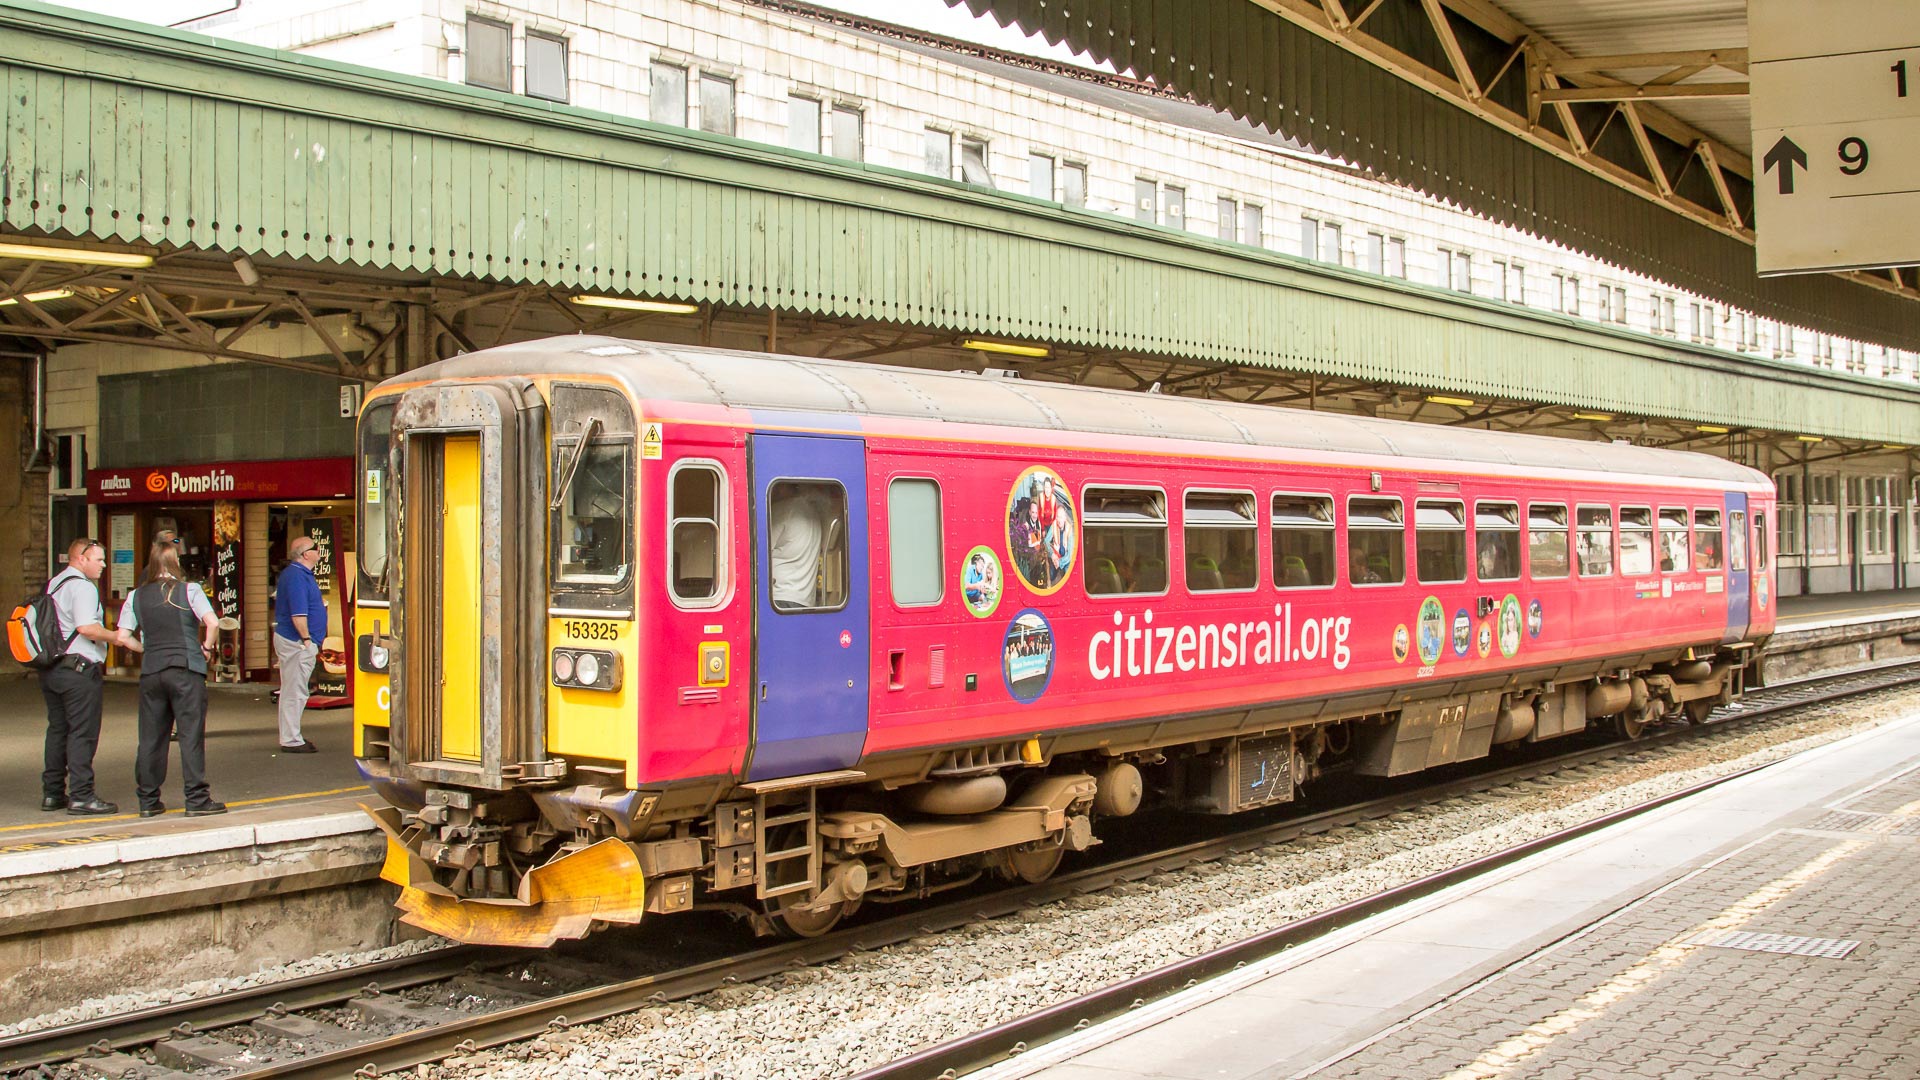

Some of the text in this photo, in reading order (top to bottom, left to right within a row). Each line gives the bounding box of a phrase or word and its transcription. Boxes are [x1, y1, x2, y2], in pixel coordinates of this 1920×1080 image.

[1838, 136, 1869, 175] 9
[171, 469, 234, 493] Pumpkin
[217, 562, 235, 576] cakes
[218, 587, 237, 602] coffee
[221, 602, 237, 615] here
[565, 621, 618, 640] 153325
[1088, 602, 1351, 680] citizensrail.org
